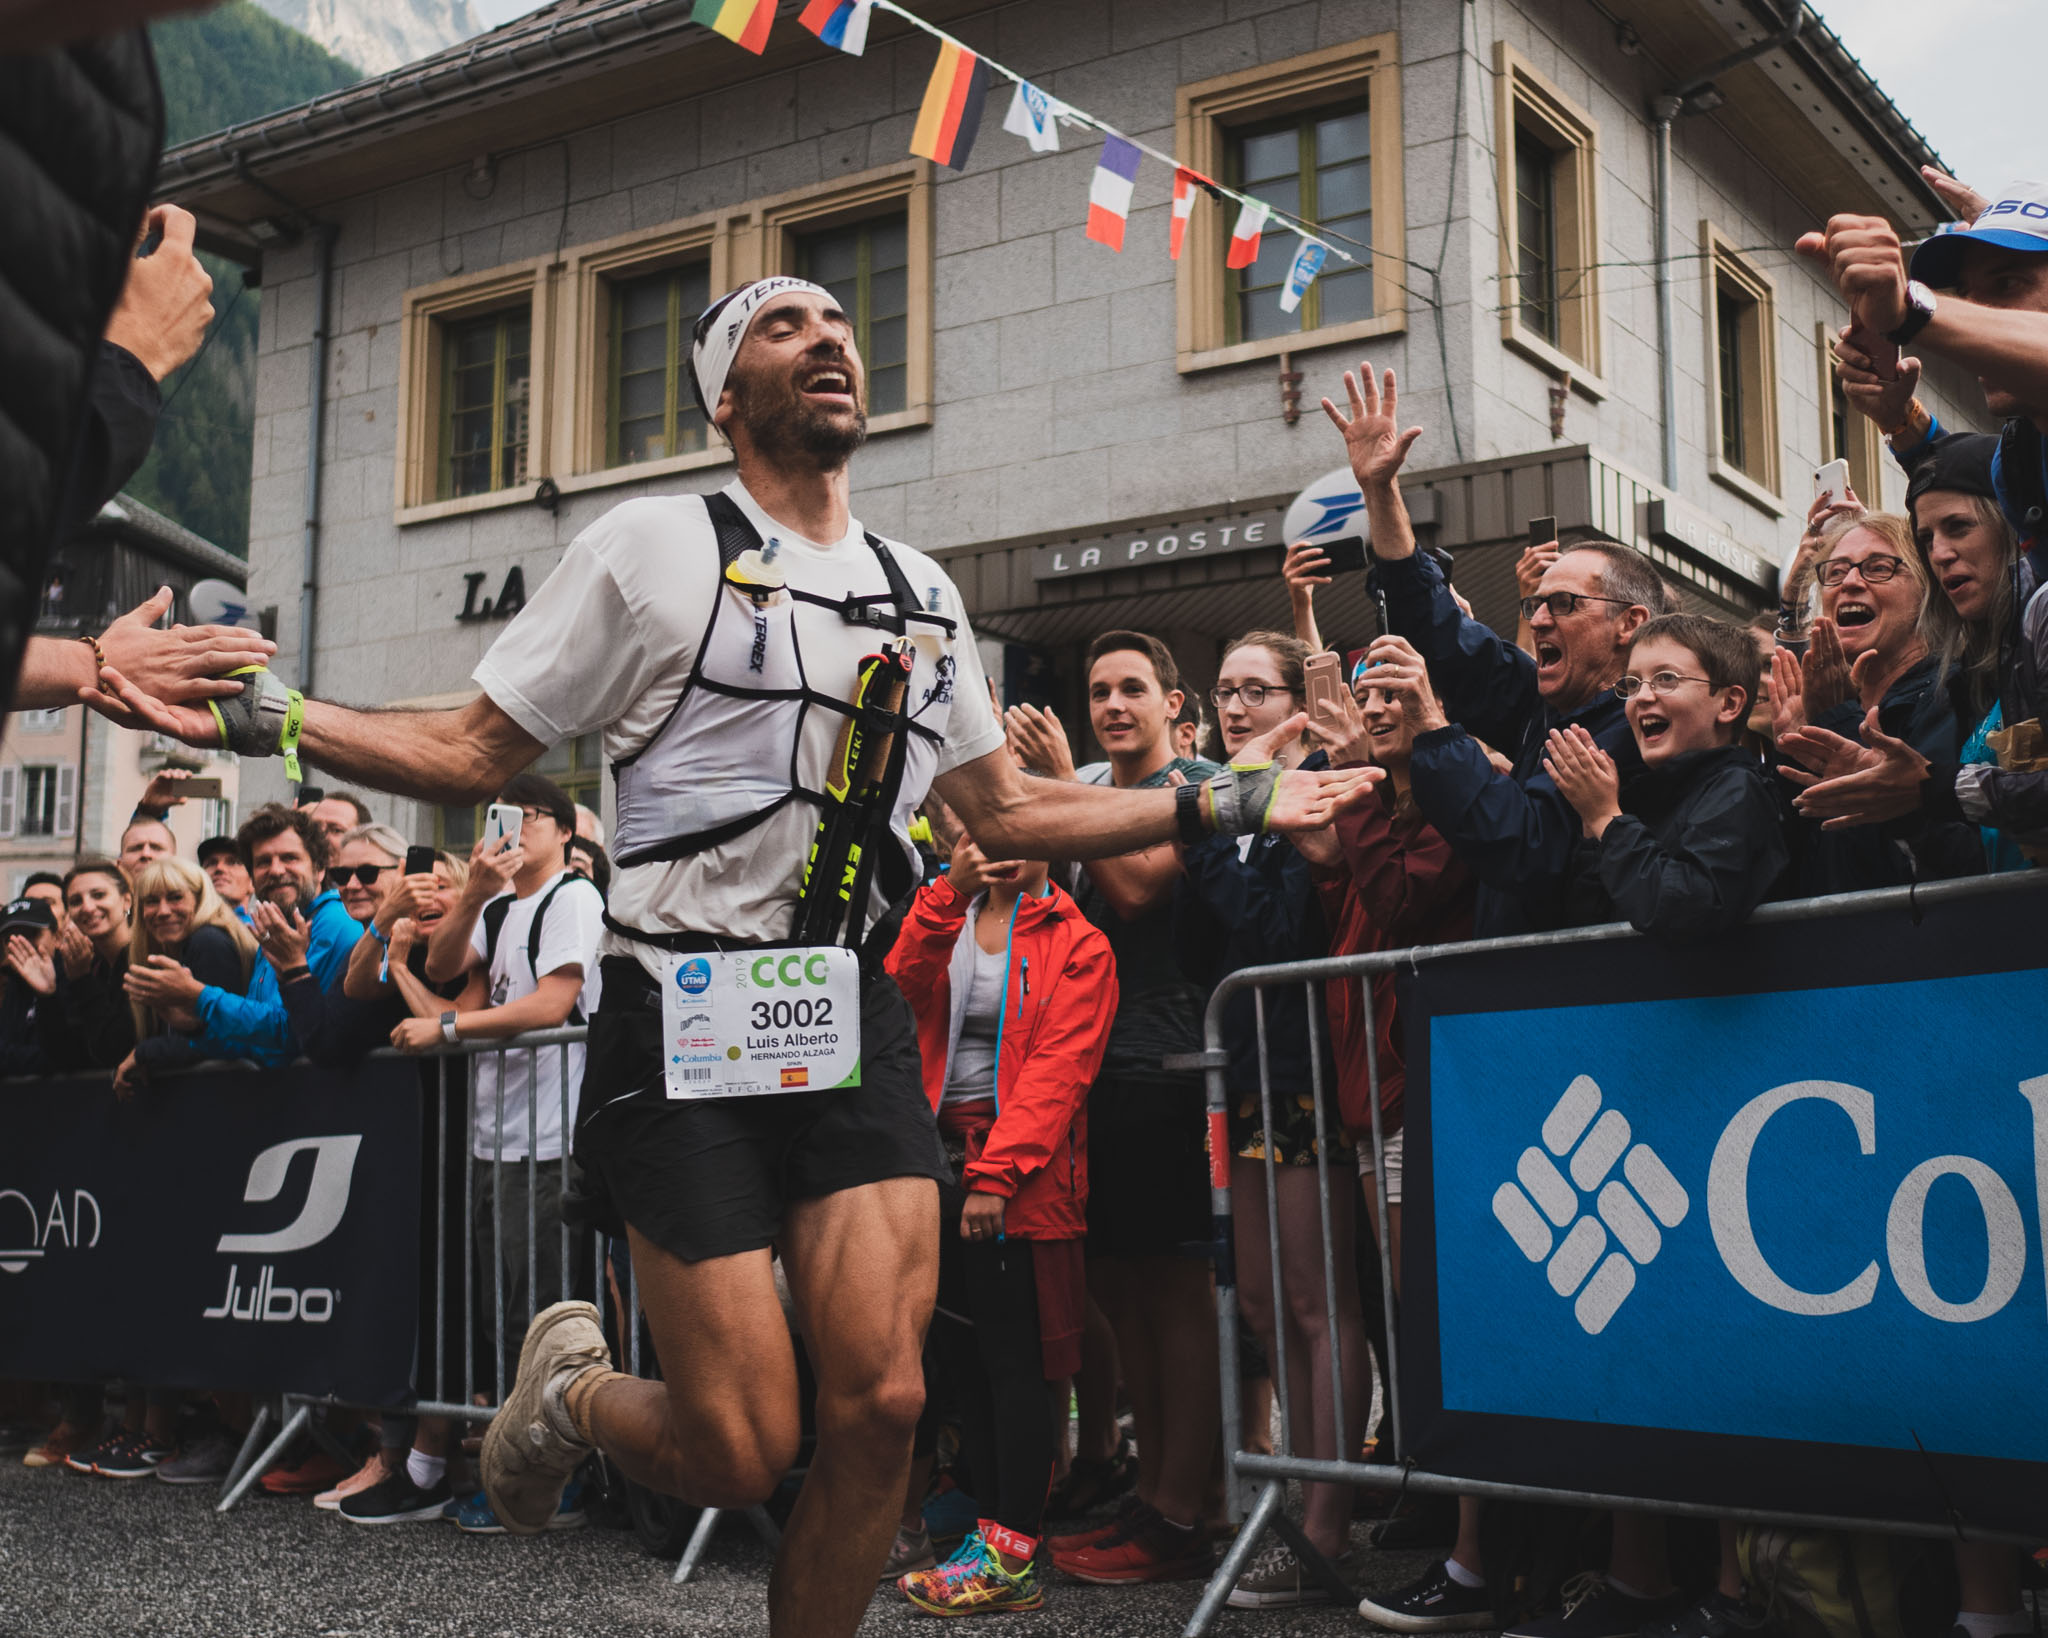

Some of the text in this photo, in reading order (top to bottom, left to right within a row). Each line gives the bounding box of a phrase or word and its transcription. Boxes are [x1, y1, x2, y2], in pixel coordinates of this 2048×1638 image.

[741, 279, 824, 312] TERRE
[1053, 522, 1266, 572] LA POSTE
[455, 565, 526, 622] LA
[749, 615, 767, 675] TERREX
[849, 730, 863, 771] LEKI
[838, 842, 862, 902] EKI
[681, 976, 707, 985] UTMB
[735, 957, 747, 989] 2019
[750, 953, 827, 988] CCC
[751, 997, 833, 1030] 3002
[746, 1032, 839, 1049] Luis Alberto
[751, 1048, 836, 1061] HERNANDO ALZAGA
[681, 1053, 722, 1063] Columbia
[203, 1264, 333, 1322] Julbo
